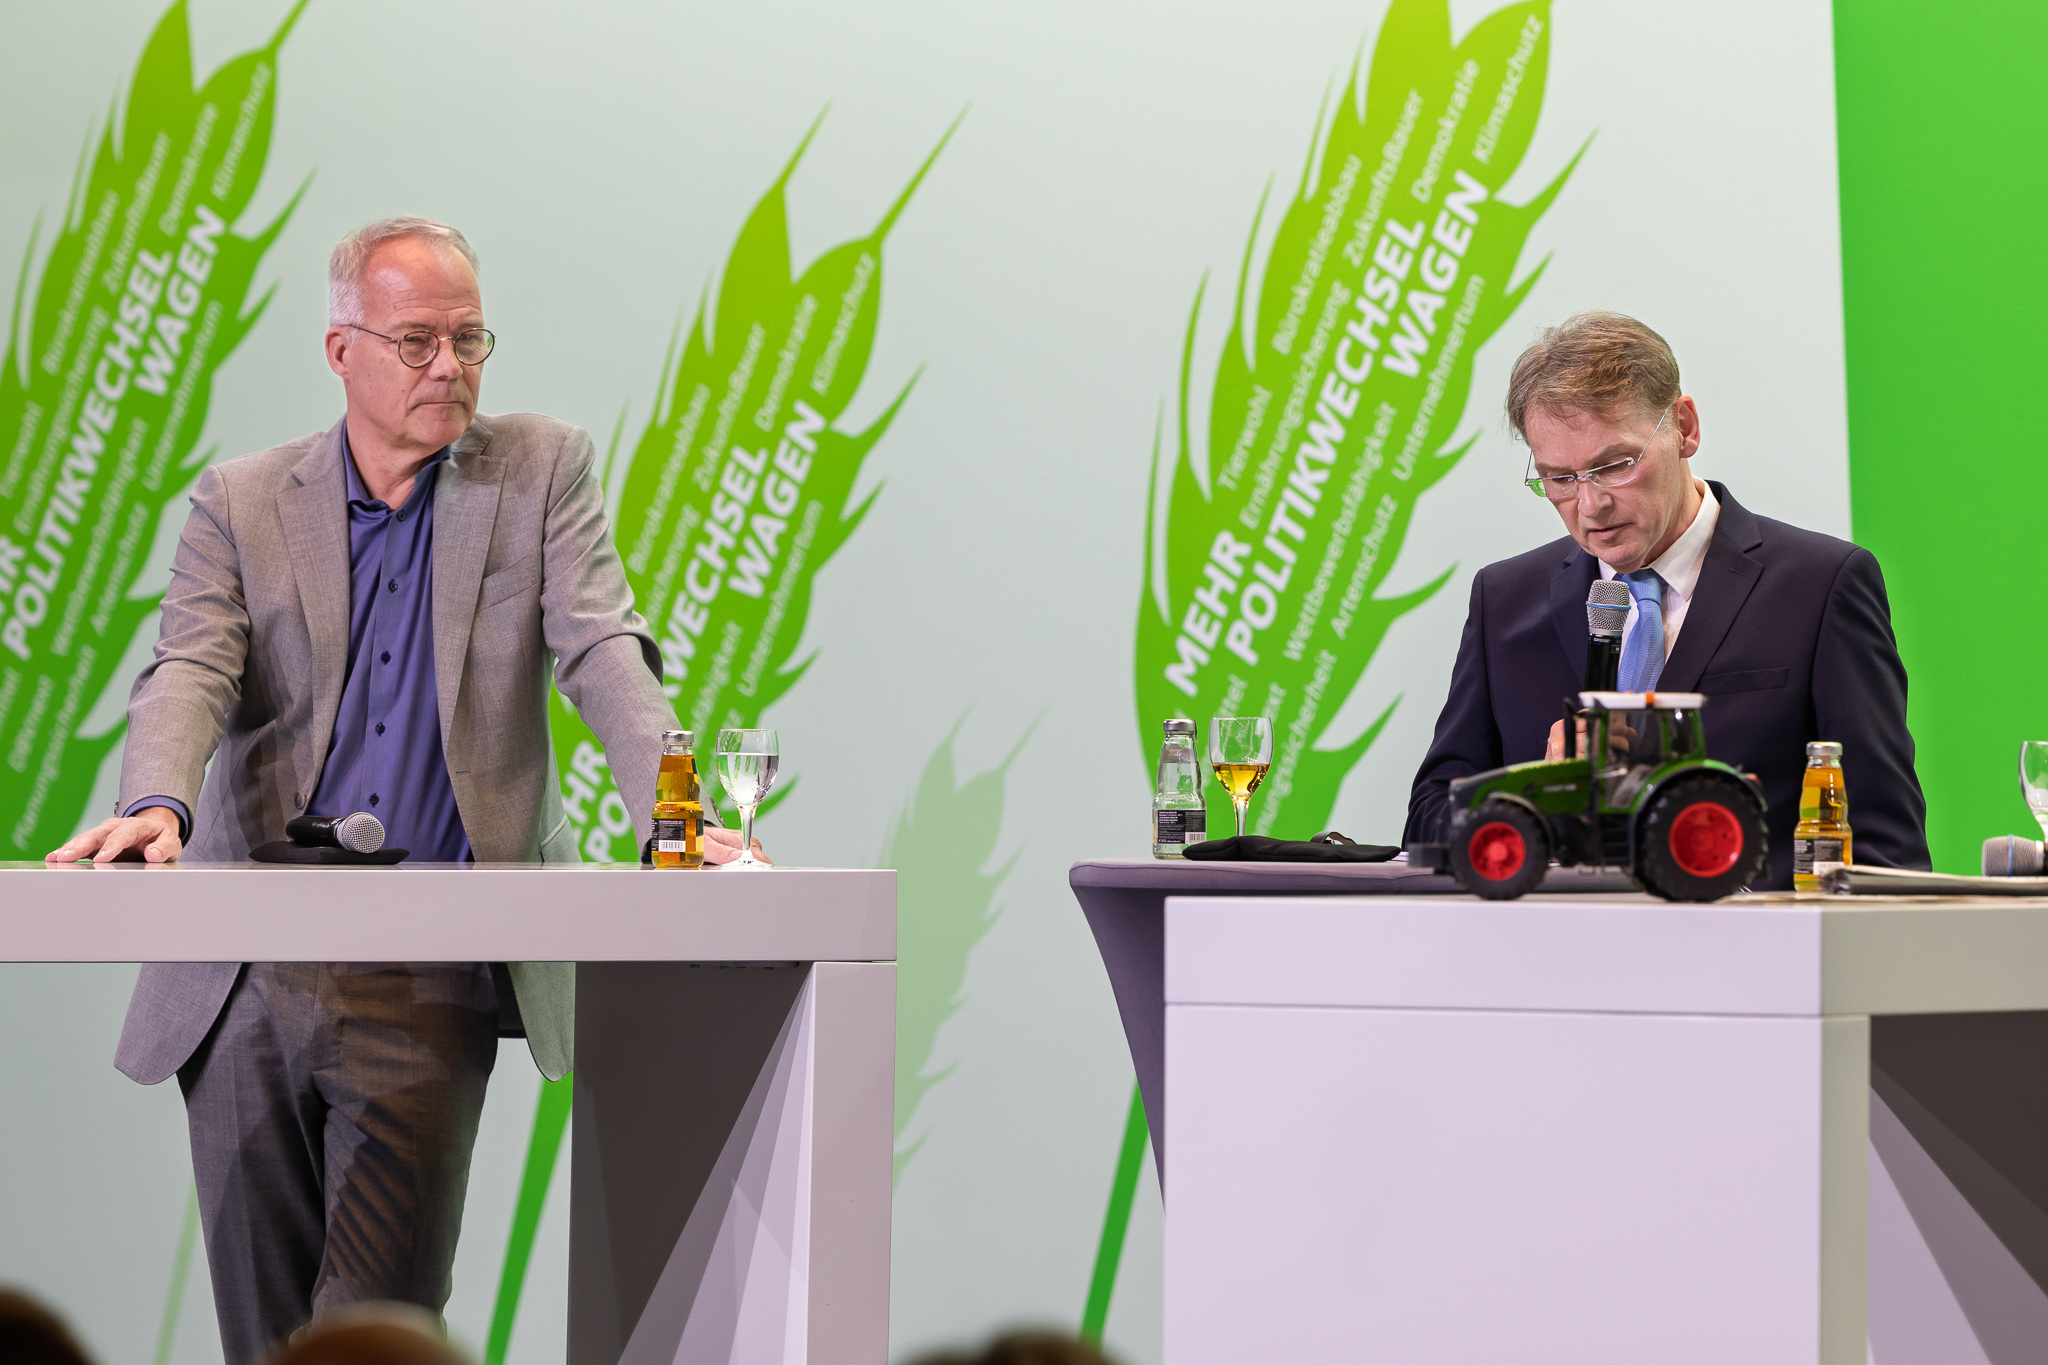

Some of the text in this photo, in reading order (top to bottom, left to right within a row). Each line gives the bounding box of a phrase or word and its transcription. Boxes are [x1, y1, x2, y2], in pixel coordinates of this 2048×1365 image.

[1344, 89, 1423, 267] ZukunftsBauer
[1411, 60, 1479, 202] Demokratie
[1473, 16, 1543, 163] Klimaschutz
[136, 205, 226, 395] WAGEN
[811, 253, 875, 395] Klimaschutz
[1272, 154, 1361, 355] Bürokratieabbau
[1382, 170, 1488, 377] WAGEN
[3, 249, 172, 660] POLITIKWECHSEL
[755, 296, 817, 432] Demokratie
[1219, 385, 1272, 490] Tierwohl
[1226, 219, 1424, 665] POLITIKWECHSEL
[1240, 282, 1349, 530] Ernährungssicherung
[1393, 274, 1484, 481] Unternehmertum
[628, 384, 709, 574] Bürokratieabbau
[729, 401, 825, 597] WAGEN
[1285, 403, 1397, 660] Wettbewerbsfähigkeit
[1332, 495, 1397, 639] Artenschutz
[739, 500, 823, 696] Unternehmertum
[1165, 531, 1250, 696] MEHR
[1257, 651, 1336, 835] nungssicherheit
